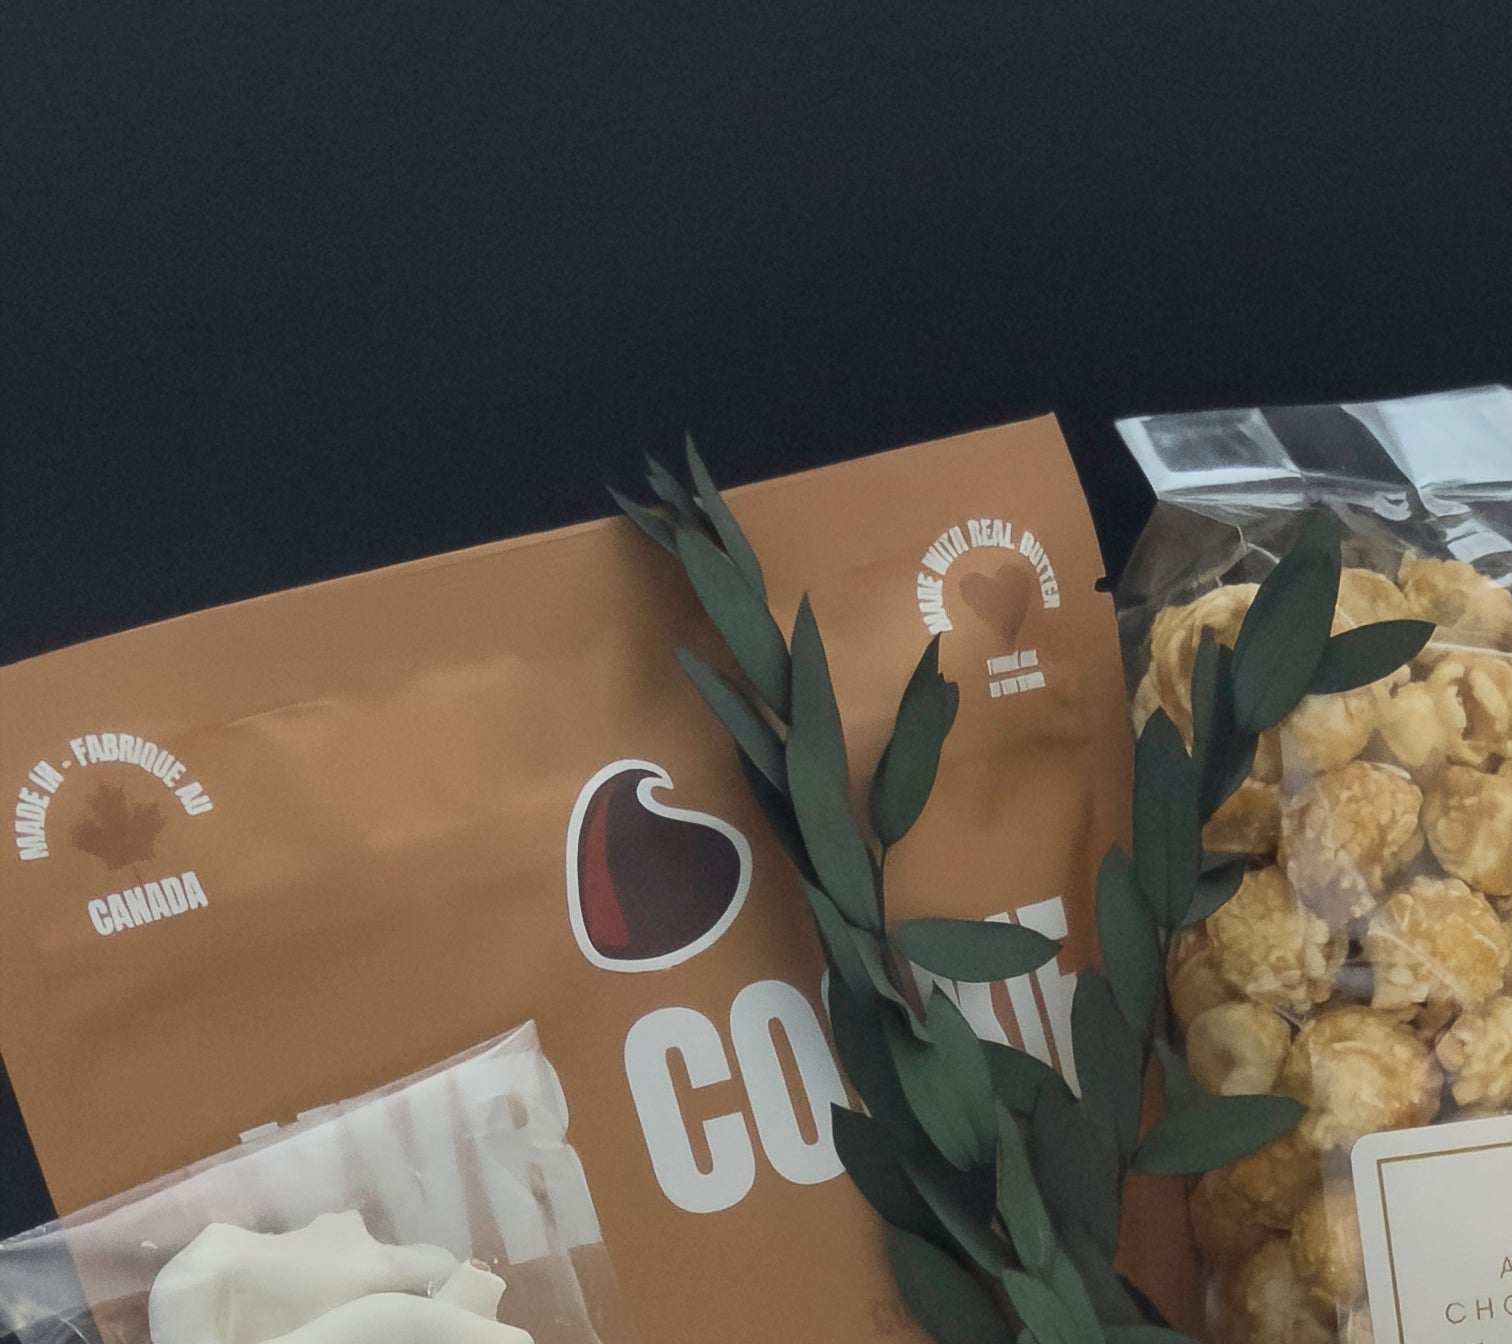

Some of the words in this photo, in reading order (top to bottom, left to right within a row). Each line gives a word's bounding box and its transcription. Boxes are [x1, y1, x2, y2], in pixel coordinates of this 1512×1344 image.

[967, 518, 1016, 550] REAL
[28, 760, 65, 793] IN
[174, 781, 214, 815] AU
[15, 787, 50, 860] MADE
[87, 870, 209, 935] CANADA
